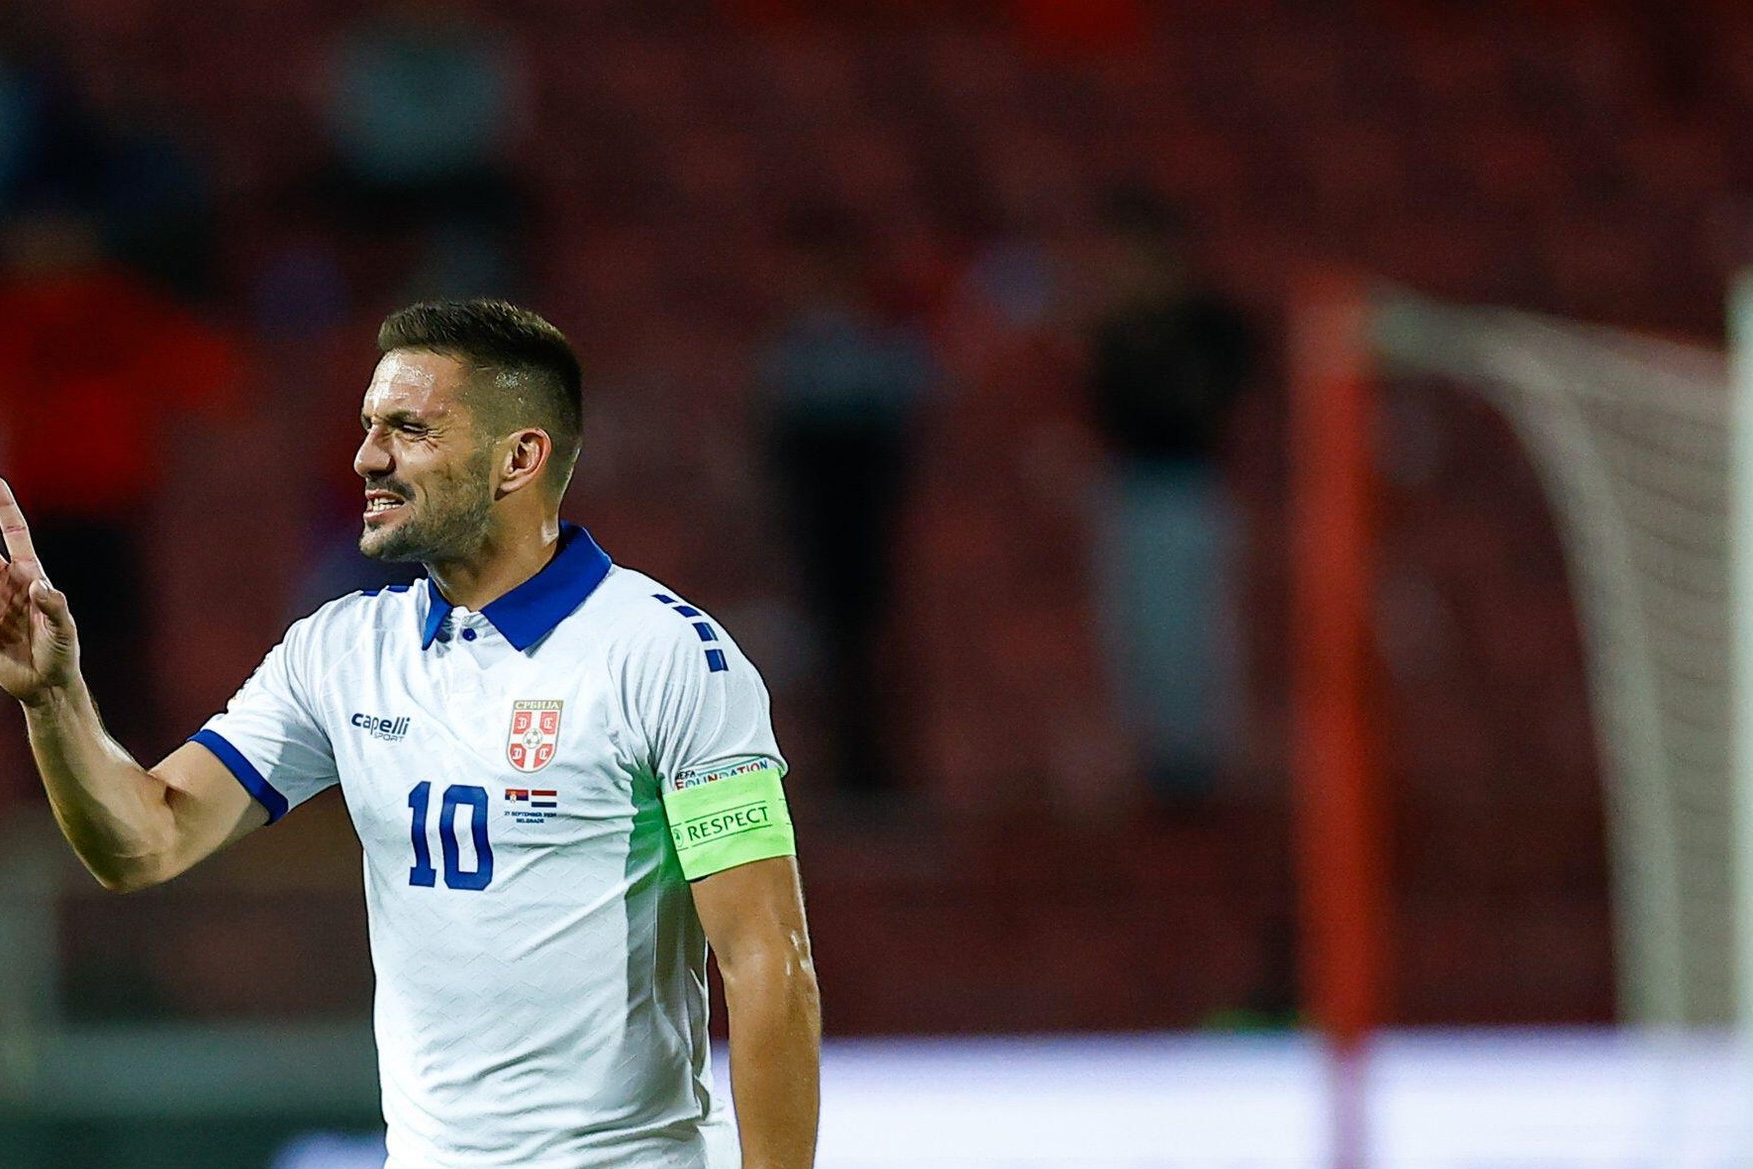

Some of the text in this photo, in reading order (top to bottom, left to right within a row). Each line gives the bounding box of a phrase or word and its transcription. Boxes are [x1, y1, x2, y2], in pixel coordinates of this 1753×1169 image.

[515, 701, 560, 710] СРБИЈА
[351, 713, 410, 735] capelli
[408, 781, 494, 891] 10
[687, 806, 769, 841] RESPECT
